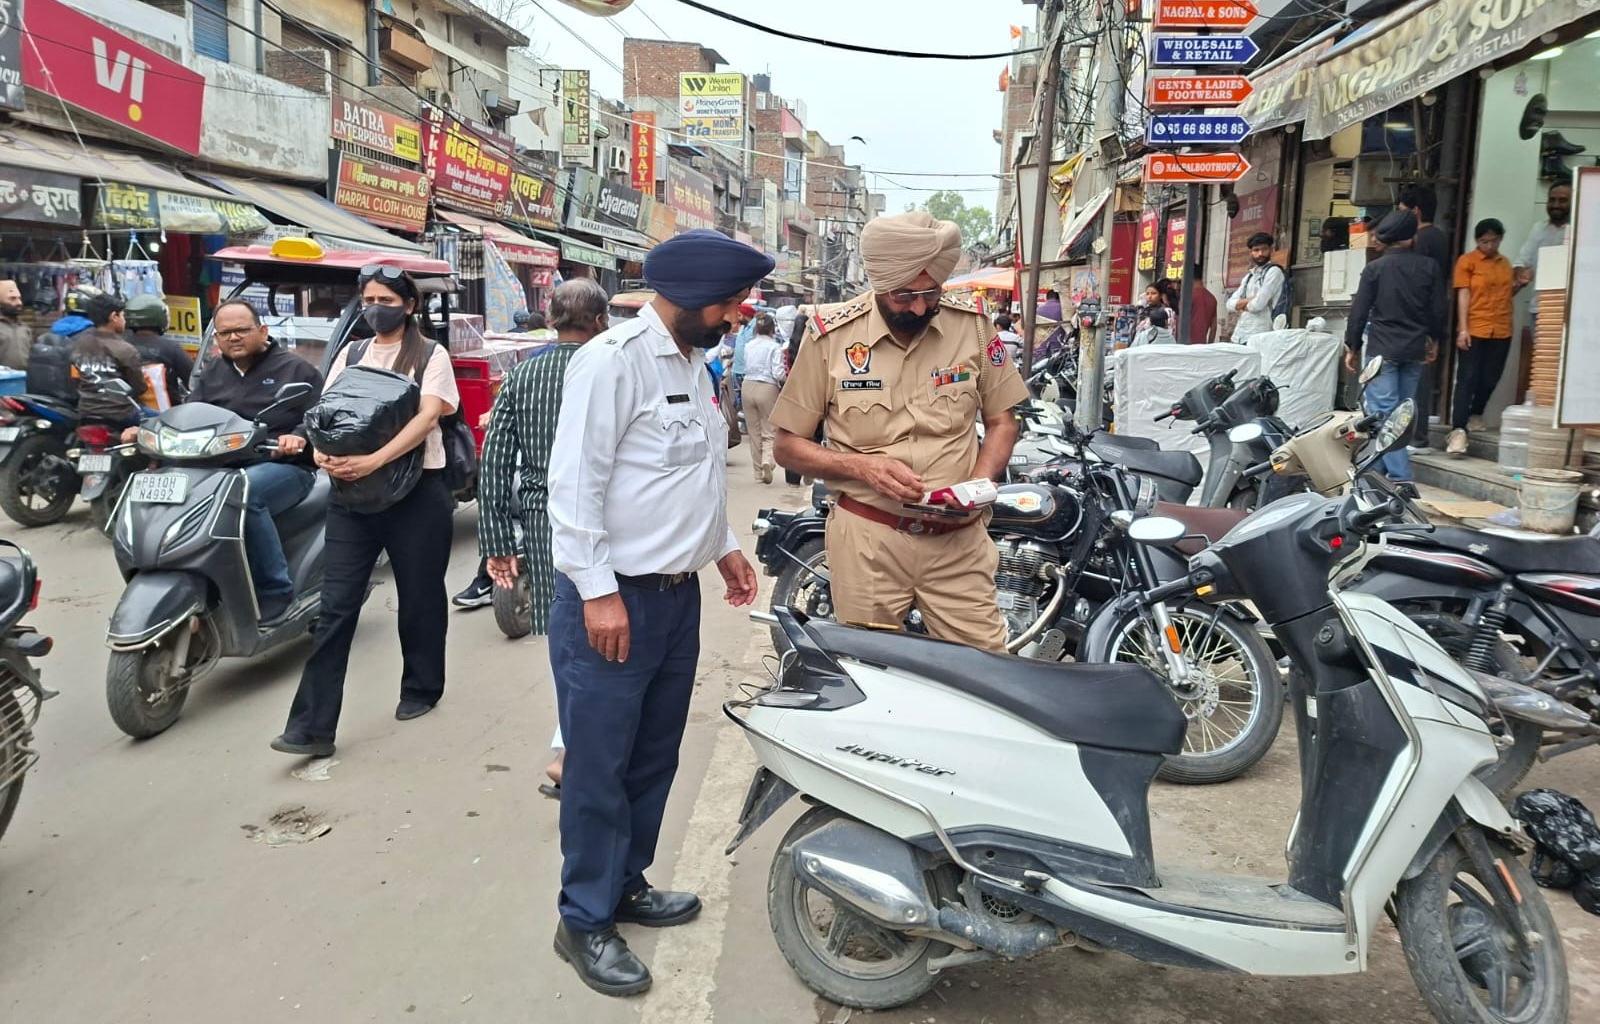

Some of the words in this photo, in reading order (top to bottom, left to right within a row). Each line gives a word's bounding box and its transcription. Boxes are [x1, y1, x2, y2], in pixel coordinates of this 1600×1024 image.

[1162, 7, 1204, 18] NAGPAL
[1207, 7, 1216, 18] &
[1218, 7, 1247, 18] SONS
[1163, 40, 1244, 50] WHOLESALE
[1172, 51, 1181, 60] &
[1185, 51, 1233, 60] RETAIL
[1322, 37, 1426, 118] NAGPAL
[1429, 20, 1458, 62] &
[1337, 103, 1365, 125] DEALS
[1385, 58, 1458, 102] WHOLESALE
[1473, 27, 1526, 60] RETAIL
[1158, 80, 1192, 90] GENTS
[1195, 81, 1203, 89] &
[1206, 80, 1244, 89] LADIES
[1167, 90, 1233, 100] FOOTWEARS
[343, 101, 385, 133] BATRA
[334, 118, 395, 151] ENTERPRISES
[1183, 124, 1196, 134] 66
[1199, 124, 1212, 134] 88
[1215, 124, 1228, 134] 88
[1231, 123, 1244, 134] 85
[338, 189, 370, 210] HARPAL
[373, 197, 400, 215] CLOTH
[402, 203, 426, 221] HOUSE
[533, 272, 550, 284] 27
[835, 744, 956, 776] Jupiter
